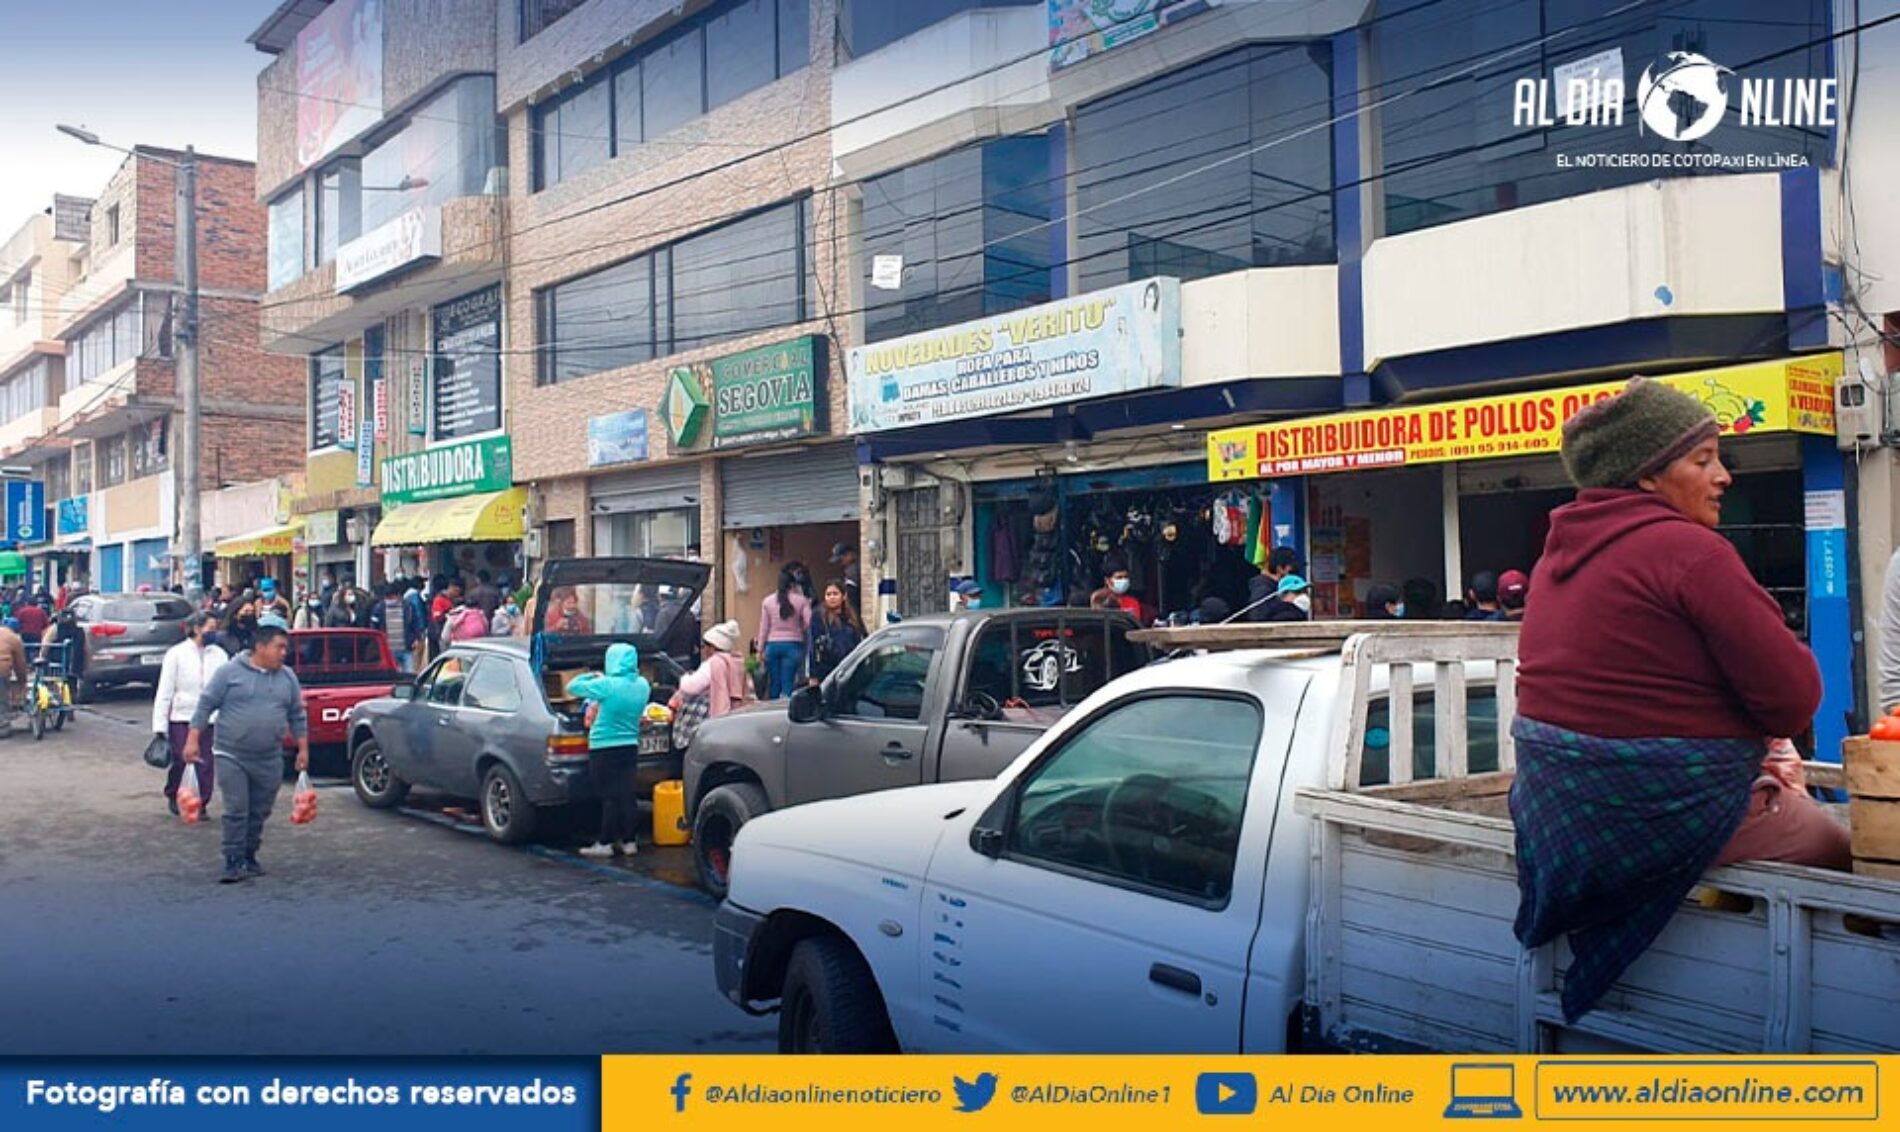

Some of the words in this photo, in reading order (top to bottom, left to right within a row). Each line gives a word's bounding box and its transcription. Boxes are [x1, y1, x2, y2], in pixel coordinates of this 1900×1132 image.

[864, 328, 994, 376] NOVEDADES
[951, 364, 1037, 394] CABALLEROS
[1037, 360, 1047, 378] Y
[1049, 349, 1100, 376] NIÑOS
[956, 354, 993, 376] ROPA
[994, 347, 1032, 369] PARA
[718, 371, 812, 416] SEGOVIA
[1256, 413, 1422, 459] DISTRIBUIDORA
[1429, 409, 1457, 442] DE
[1464, 397, 1556, 439] POLLOS
[381, 443, 485, 493] DISTRIBUIDORA
[1260, 462, 1274, 474] AL
[1276, 460, 1299, 472] POR
[1302, 455, 1344, 470] MAYOR
[1346, 453, 1356, 465] Y
[1357, 449, 1404, 465] MENOR
